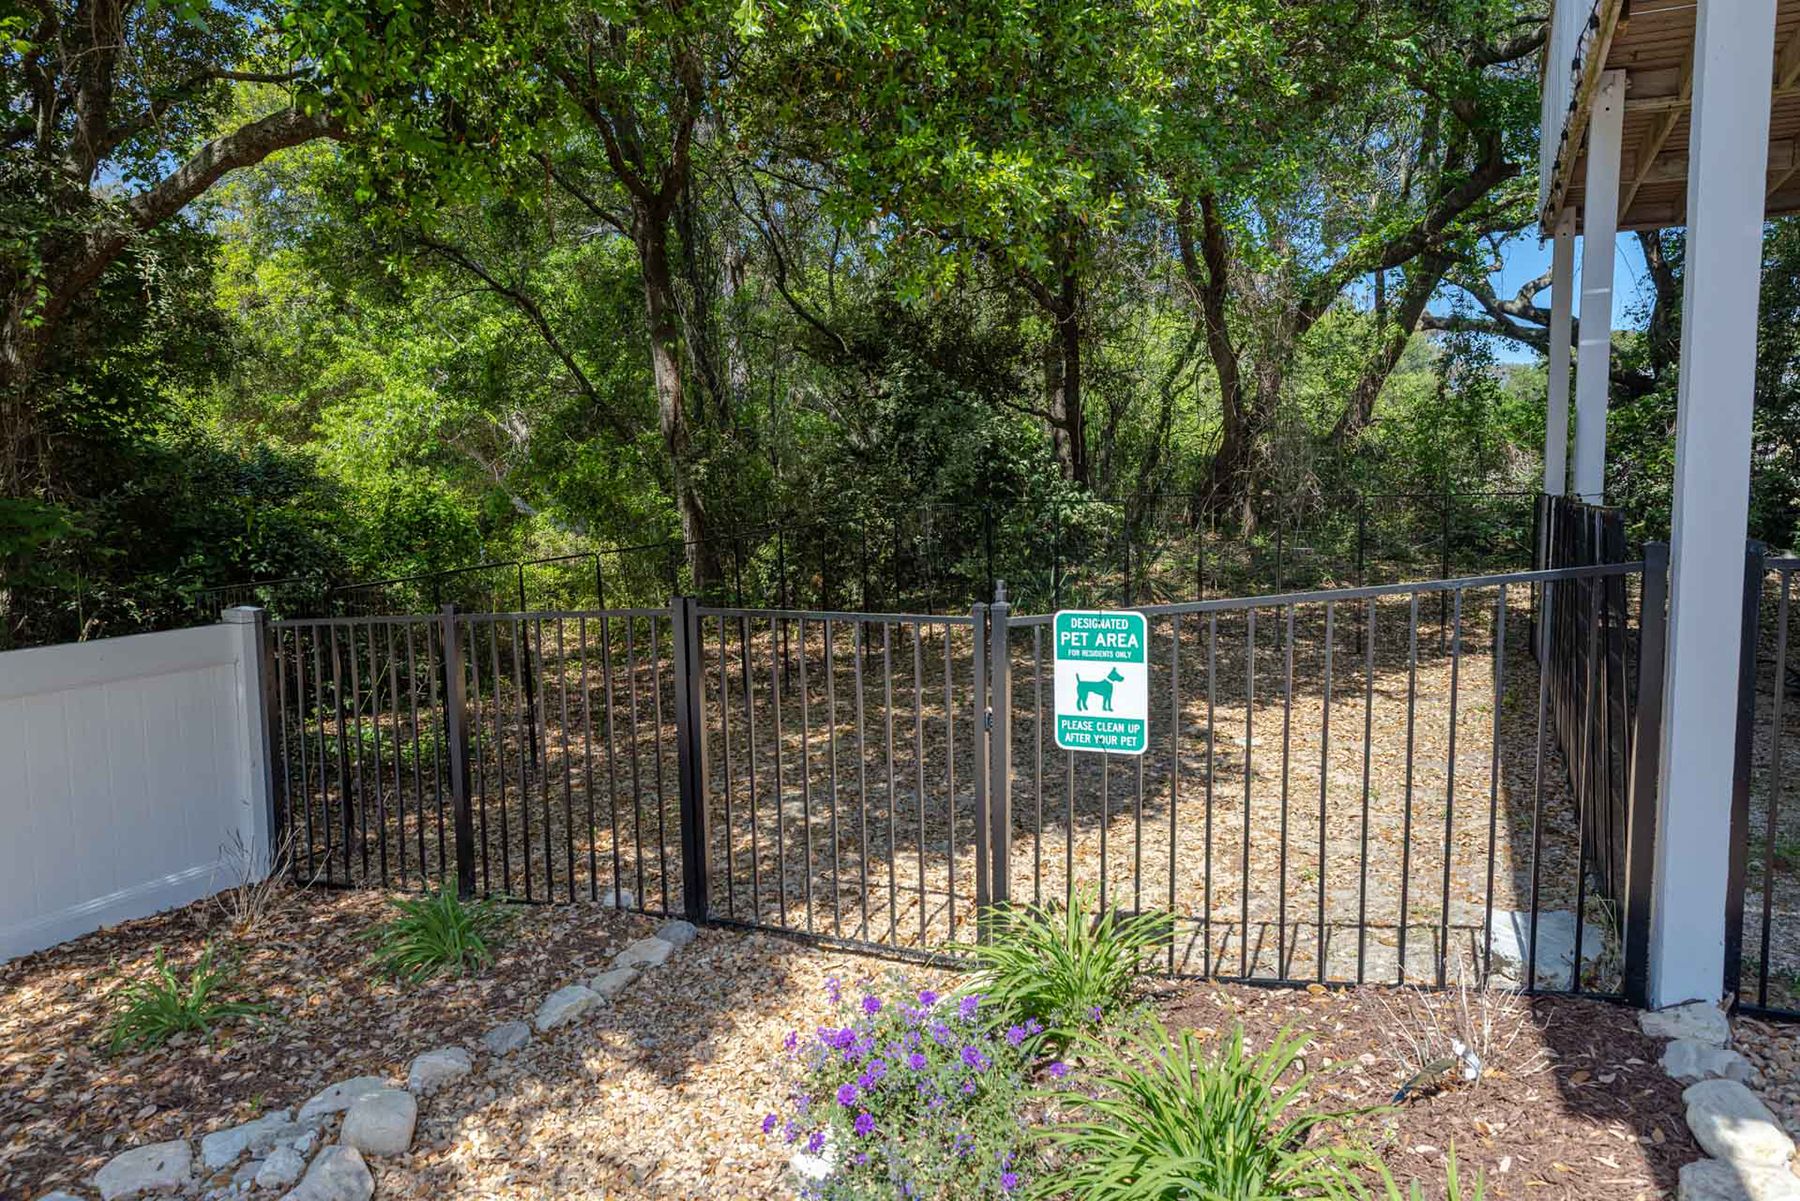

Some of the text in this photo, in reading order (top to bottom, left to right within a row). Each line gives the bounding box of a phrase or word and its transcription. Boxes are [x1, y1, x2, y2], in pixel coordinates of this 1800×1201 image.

[1070, 617, 1129, 630] DESIGNATED
[1060, 631, 1139, 649] PET AREA
[1068, 648, 1132, 659] FOR RESIDENTS ONLY
[1061, 719, 1141, 734] PLEASE CLEAN UP
[1064, 732, 1137, 747] AFTER YOUR PET
